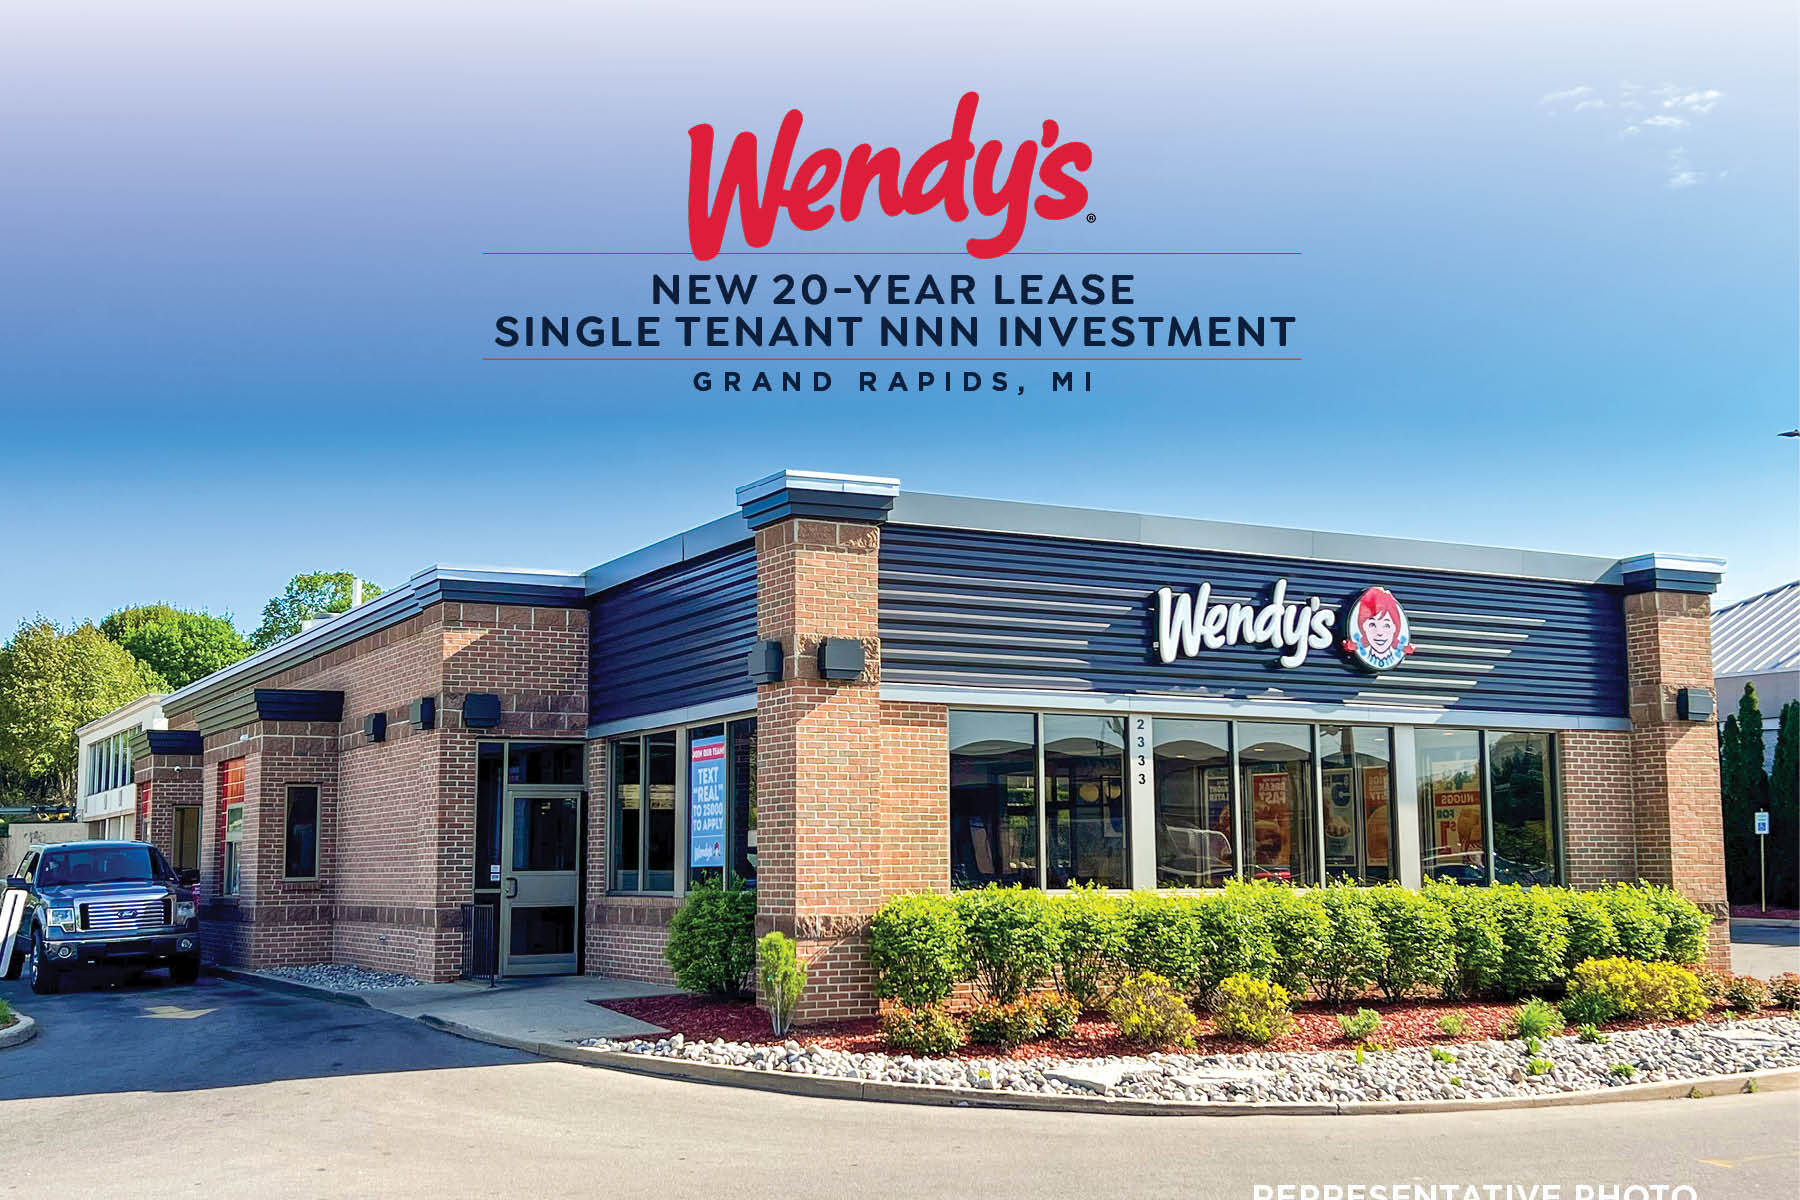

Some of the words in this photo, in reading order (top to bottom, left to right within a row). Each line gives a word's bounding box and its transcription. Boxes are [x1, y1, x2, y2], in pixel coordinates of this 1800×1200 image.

[1158, 578, 1335, 668] Wendy's
[1136, 718, 1146, 785] 2333
[698, 766, 719, 784] TEXT
[693, 804, 701, 817] TO
[693, 819, 702, 832] TO
[703, 816, 723, 831] APPLY
